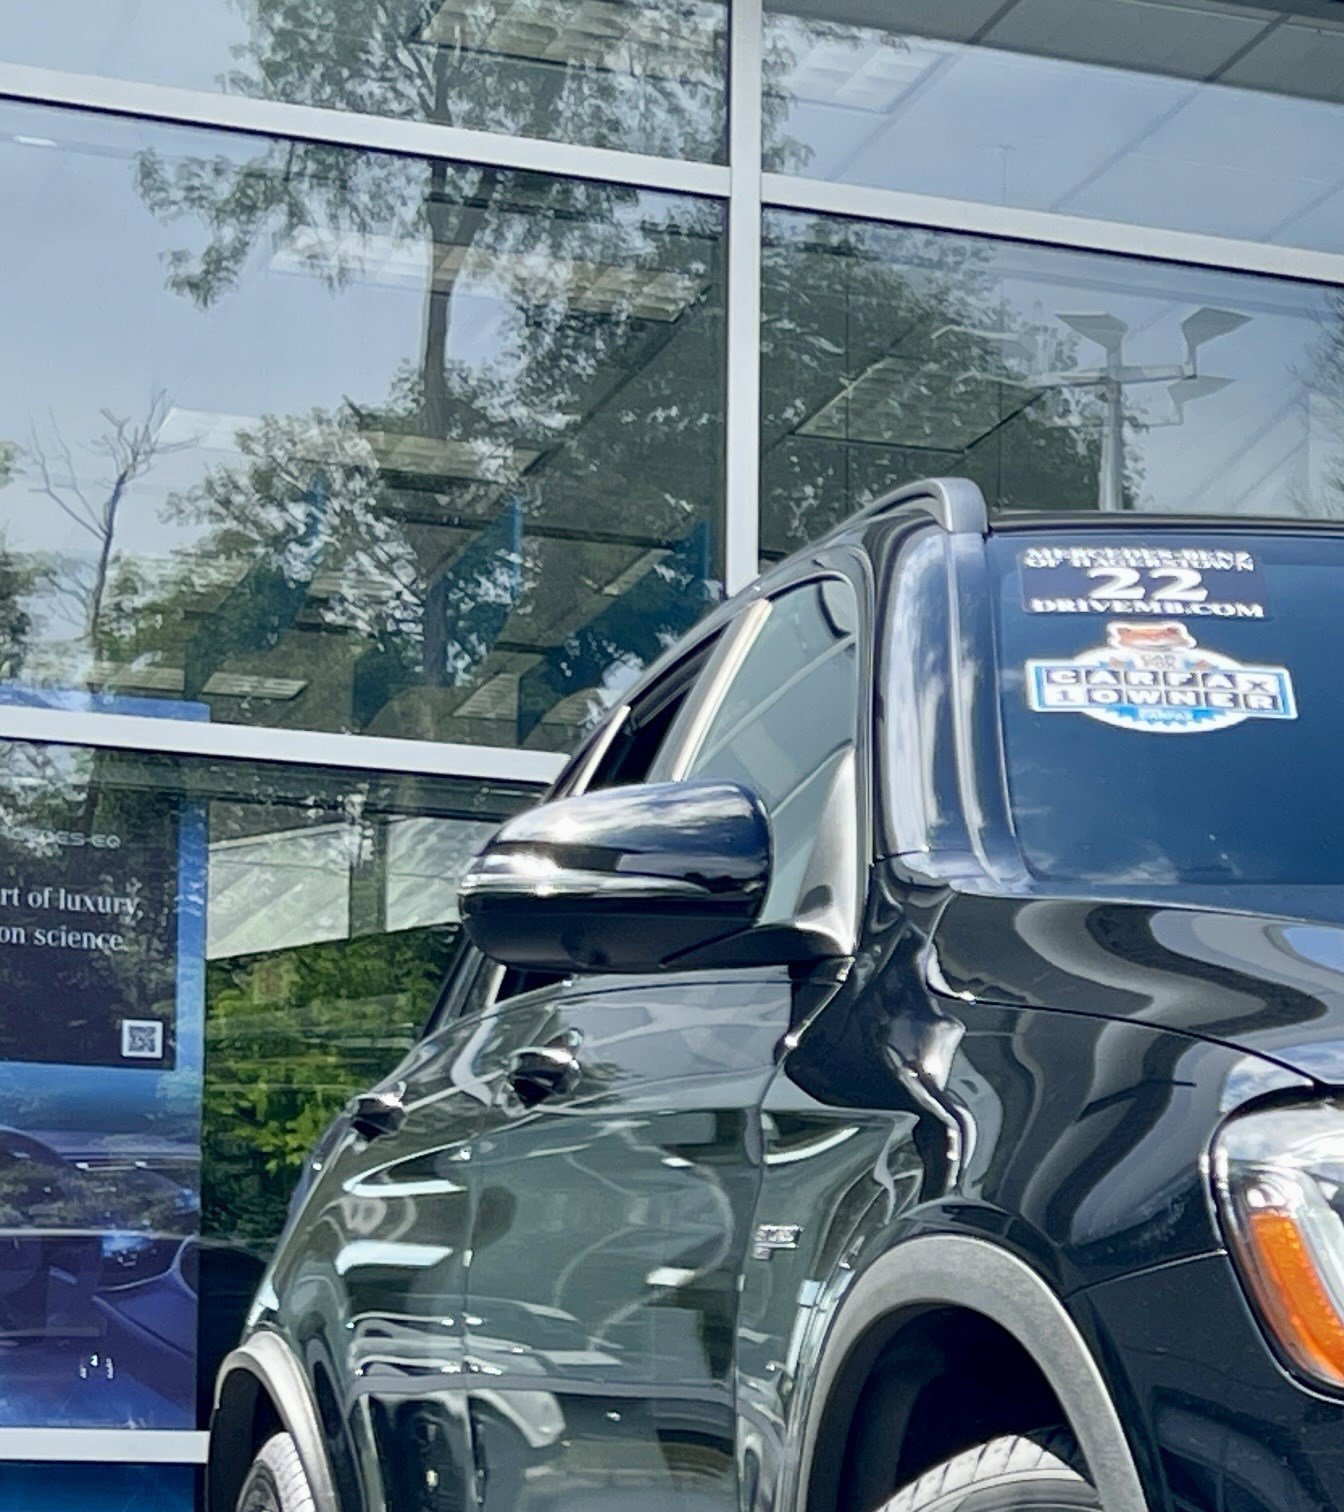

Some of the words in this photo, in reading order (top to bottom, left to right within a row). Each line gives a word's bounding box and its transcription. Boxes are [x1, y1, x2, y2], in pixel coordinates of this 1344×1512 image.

[1087, 567, 1209, 602] 22
[1049, 669, 1270, 693] CARFAX
[1090, 689, 1277, 710] OWNER
[27, 887, 53, 909] of
